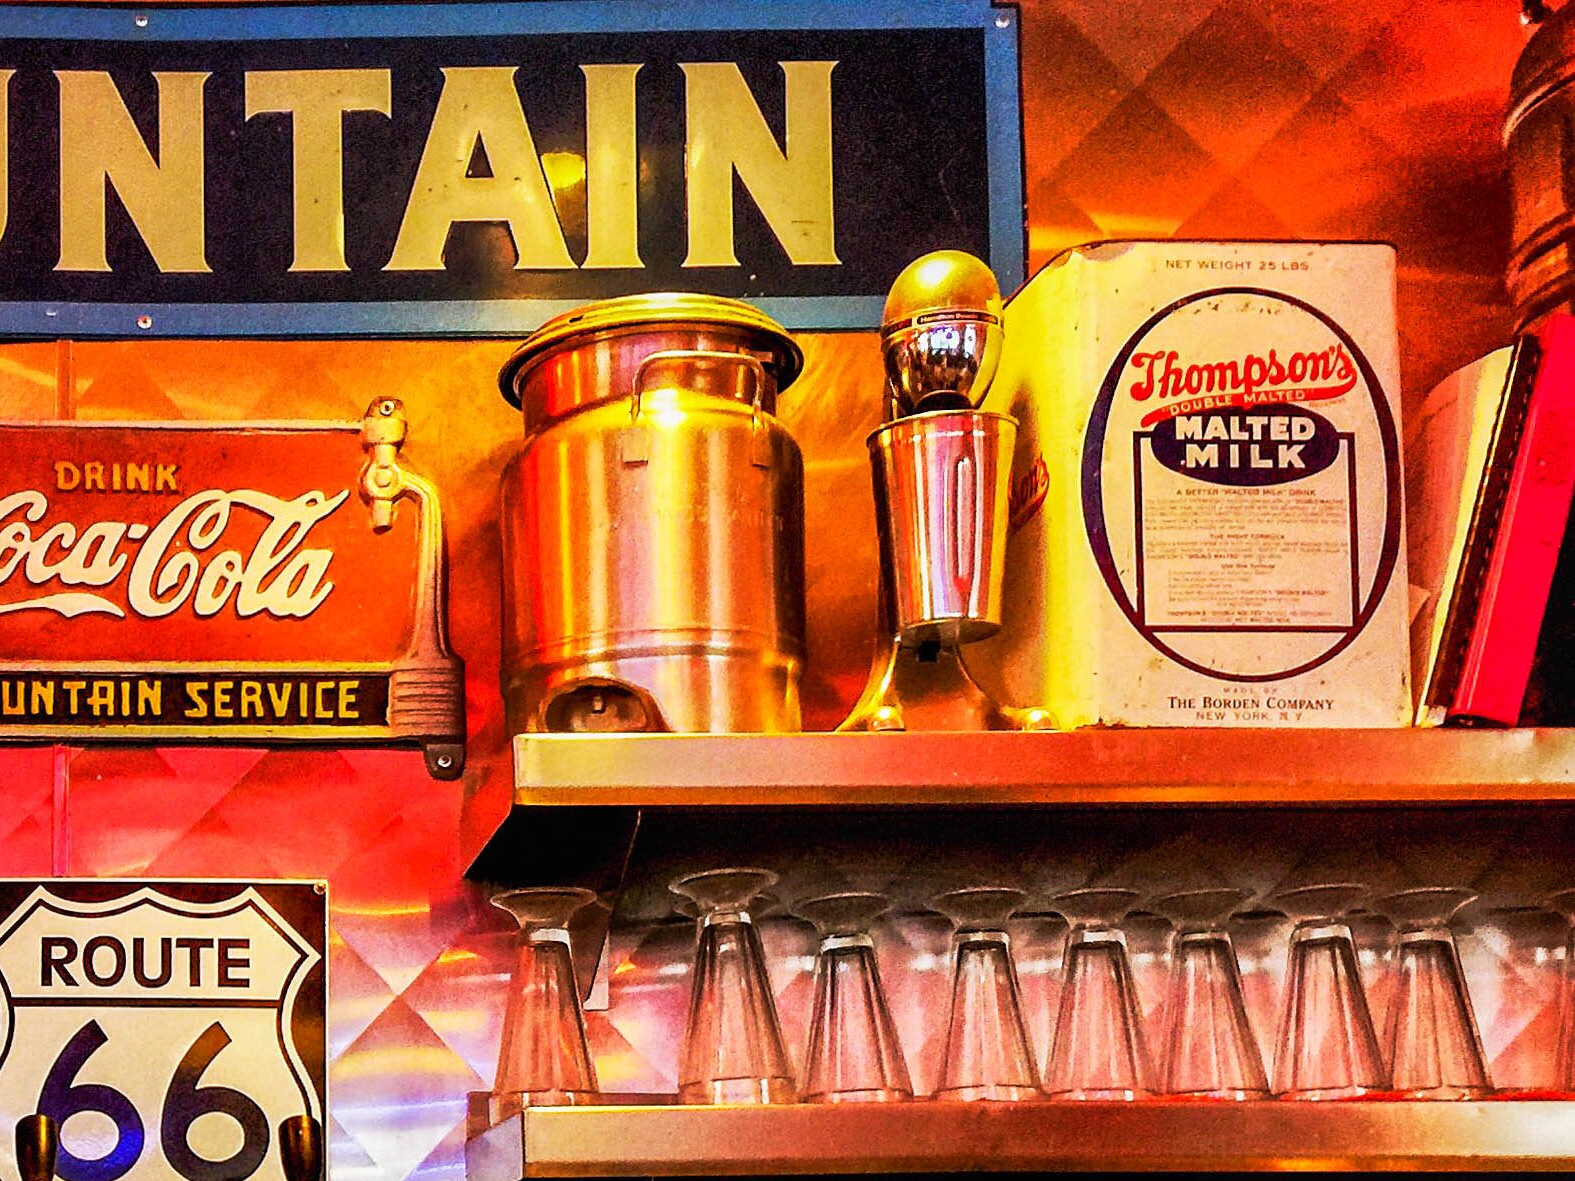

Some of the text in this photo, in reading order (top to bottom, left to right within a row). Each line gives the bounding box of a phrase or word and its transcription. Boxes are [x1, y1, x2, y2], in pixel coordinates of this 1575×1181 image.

[1166, 260, 1192, 269] NET
[1197, 260, 1253, 270] WEIGHT
[1259, 261, 1276, 270] 25
[1130, 342, 1357, 405] Thompson's
[1176, 415, 1316, 441] MALTED
[1185, 443, 1307, 469] MILK
[54, 460, 181, 493] DRINK
[184, 679, 361, 721] SERVICE
[1203, 696, 1260, 710] BORDEN
[1266, 697, 1334, 710] COMPANY
[1196, 711, 1226, 721] NEW
[40, 934, 251, 989] ROUTE
